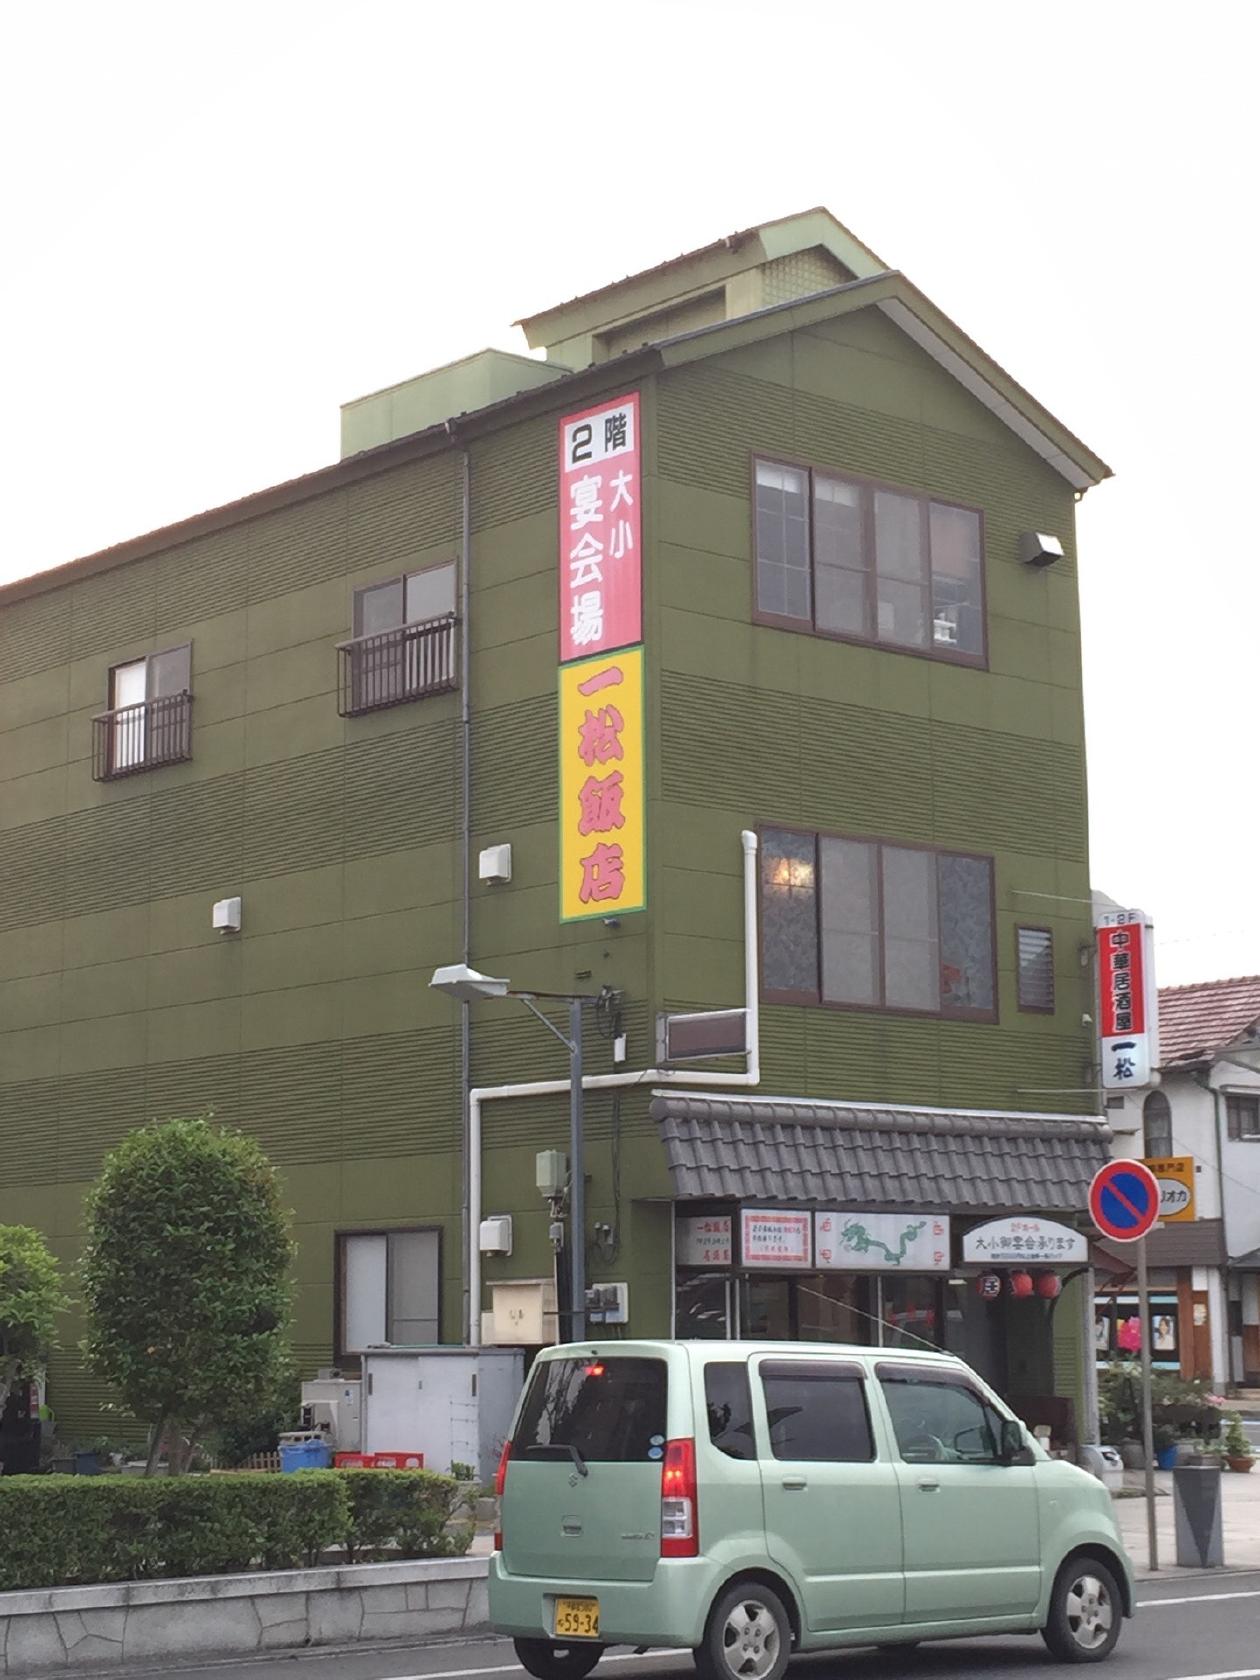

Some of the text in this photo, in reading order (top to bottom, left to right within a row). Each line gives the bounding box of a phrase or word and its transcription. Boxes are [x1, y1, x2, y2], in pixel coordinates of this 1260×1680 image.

[571, 412, 627, 464] 2階
[570, 475, 604, 647] 宴会場
[577, 665, 626, 904] 一松飯店
[1110, 930, 1132, 1032] 中華居酒屋
[1111, 1041, 1137, 1081] 一松
